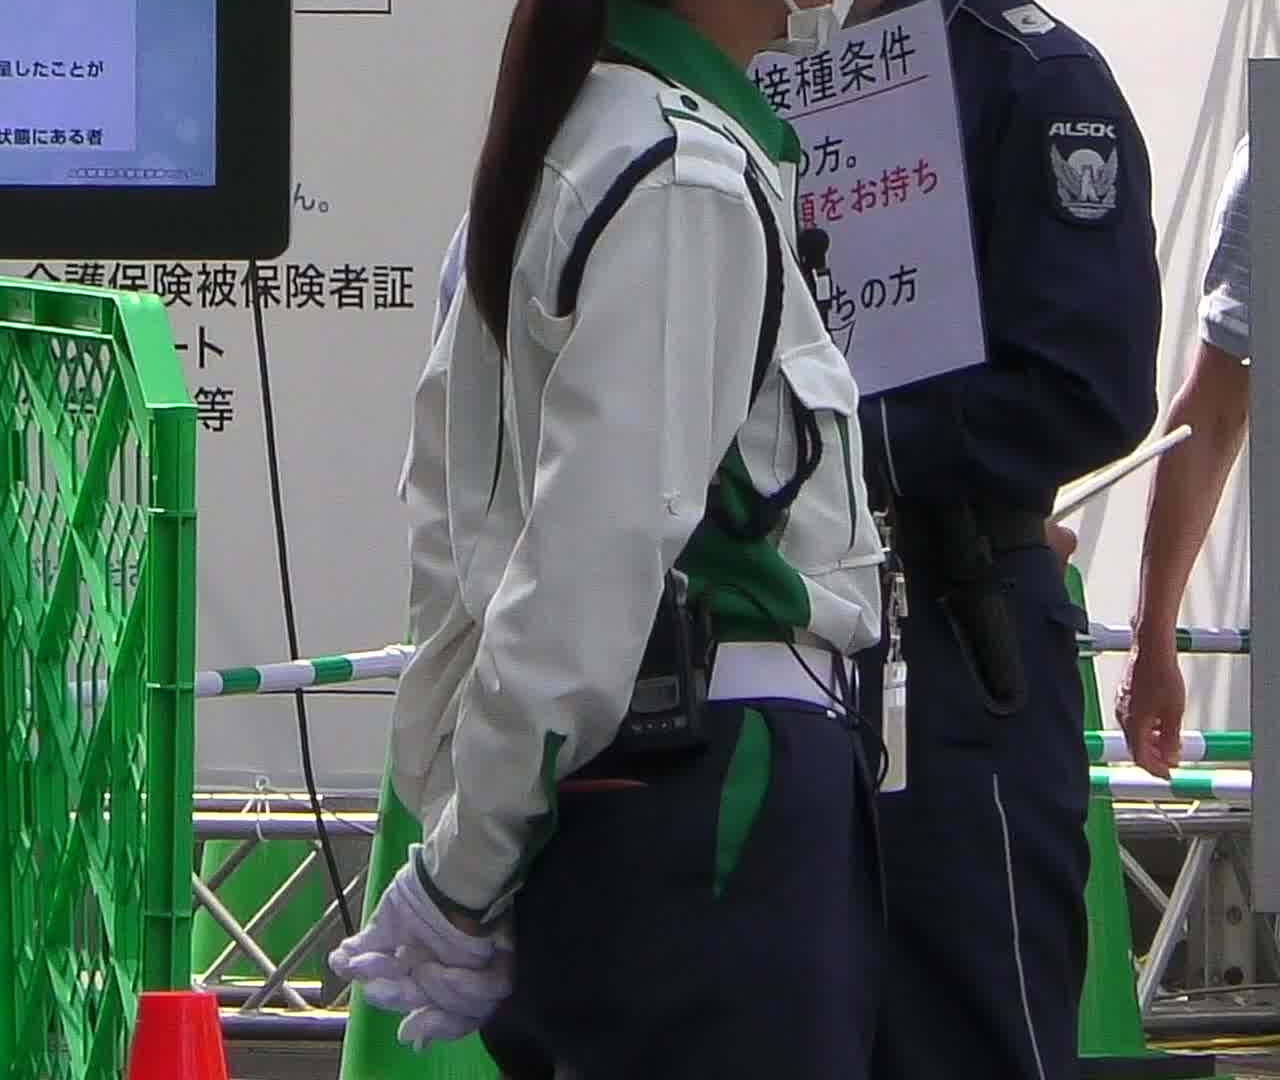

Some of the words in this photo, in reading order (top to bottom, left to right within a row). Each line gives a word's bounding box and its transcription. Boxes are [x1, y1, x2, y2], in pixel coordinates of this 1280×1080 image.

[753, 25, 916, 113] 接種条件
[1048, 122, 1117, 139] ALSOK
